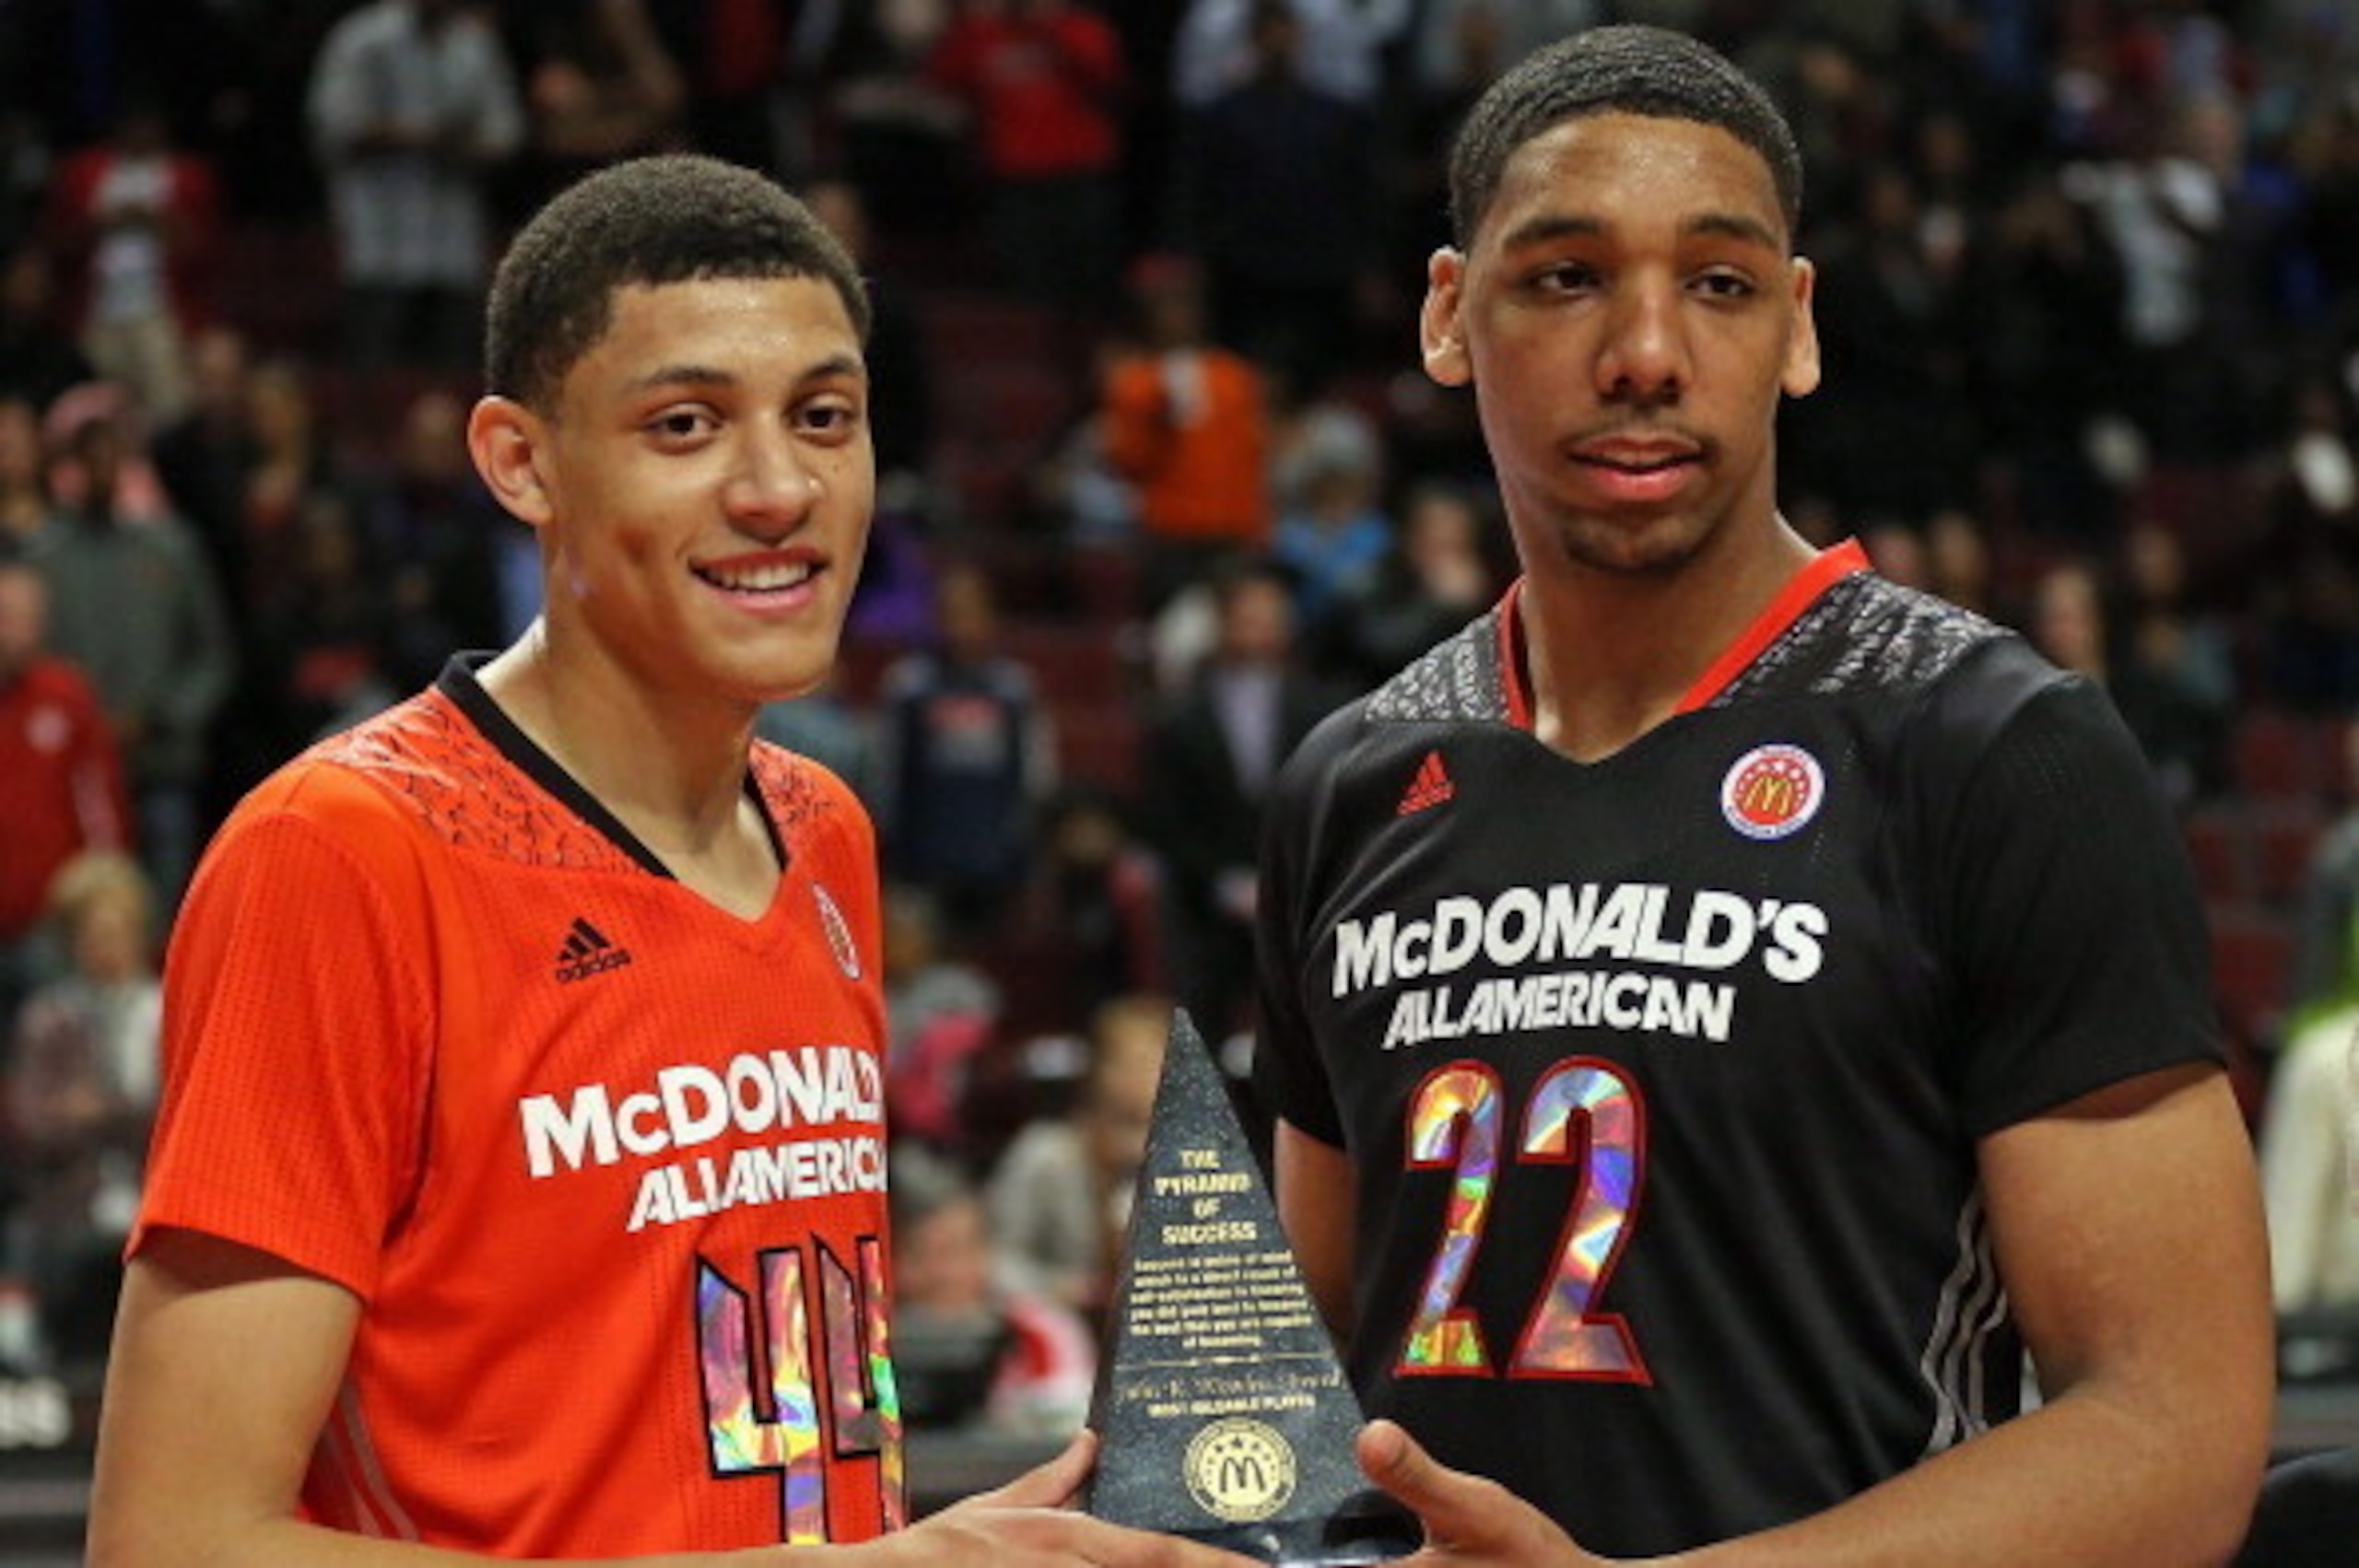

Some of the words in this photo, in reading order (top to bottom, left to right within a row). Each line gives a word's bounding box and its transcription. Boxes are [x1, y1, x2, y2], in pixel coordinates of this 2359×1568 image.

[1332, 883, 1829, 998] McDONALD'S
[1162, 1221, 1258, 1245] SUCCESS
[1192, 1198, 1222, 1220] OF
[1393, 1055, 1653, 1385] 22
[694, 1230, 908, 1548] 44
